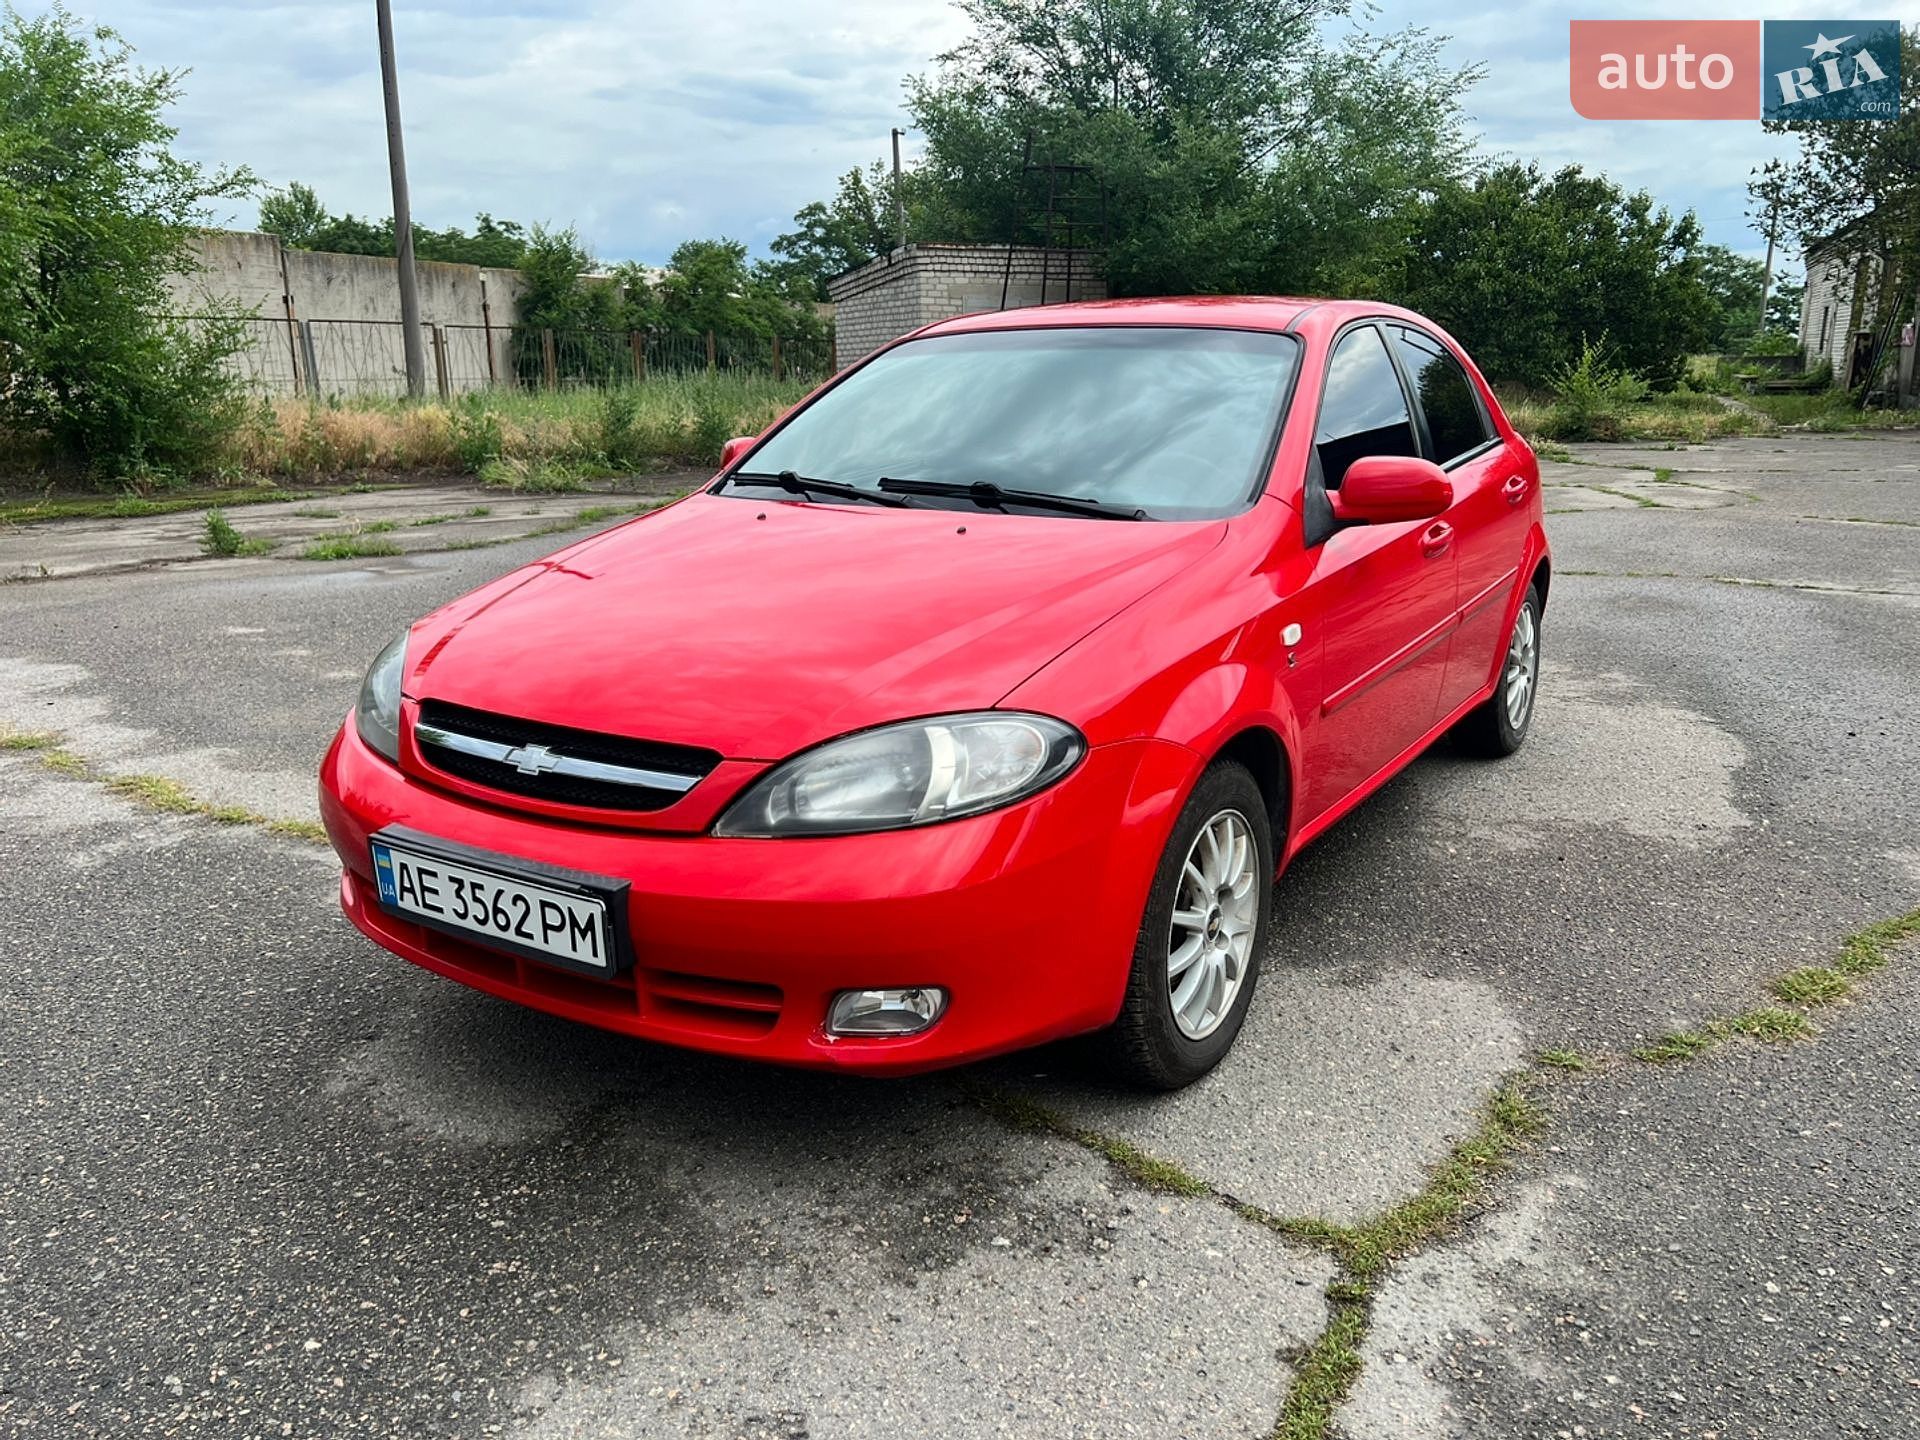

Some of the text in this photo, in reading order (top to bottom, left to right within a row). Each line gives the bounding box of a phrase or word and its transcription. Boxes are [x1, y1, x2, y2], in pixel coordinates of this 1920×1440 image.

[381, 880, 396, 897] UA
[399, 861, 600, 959] AE 3562 PM
